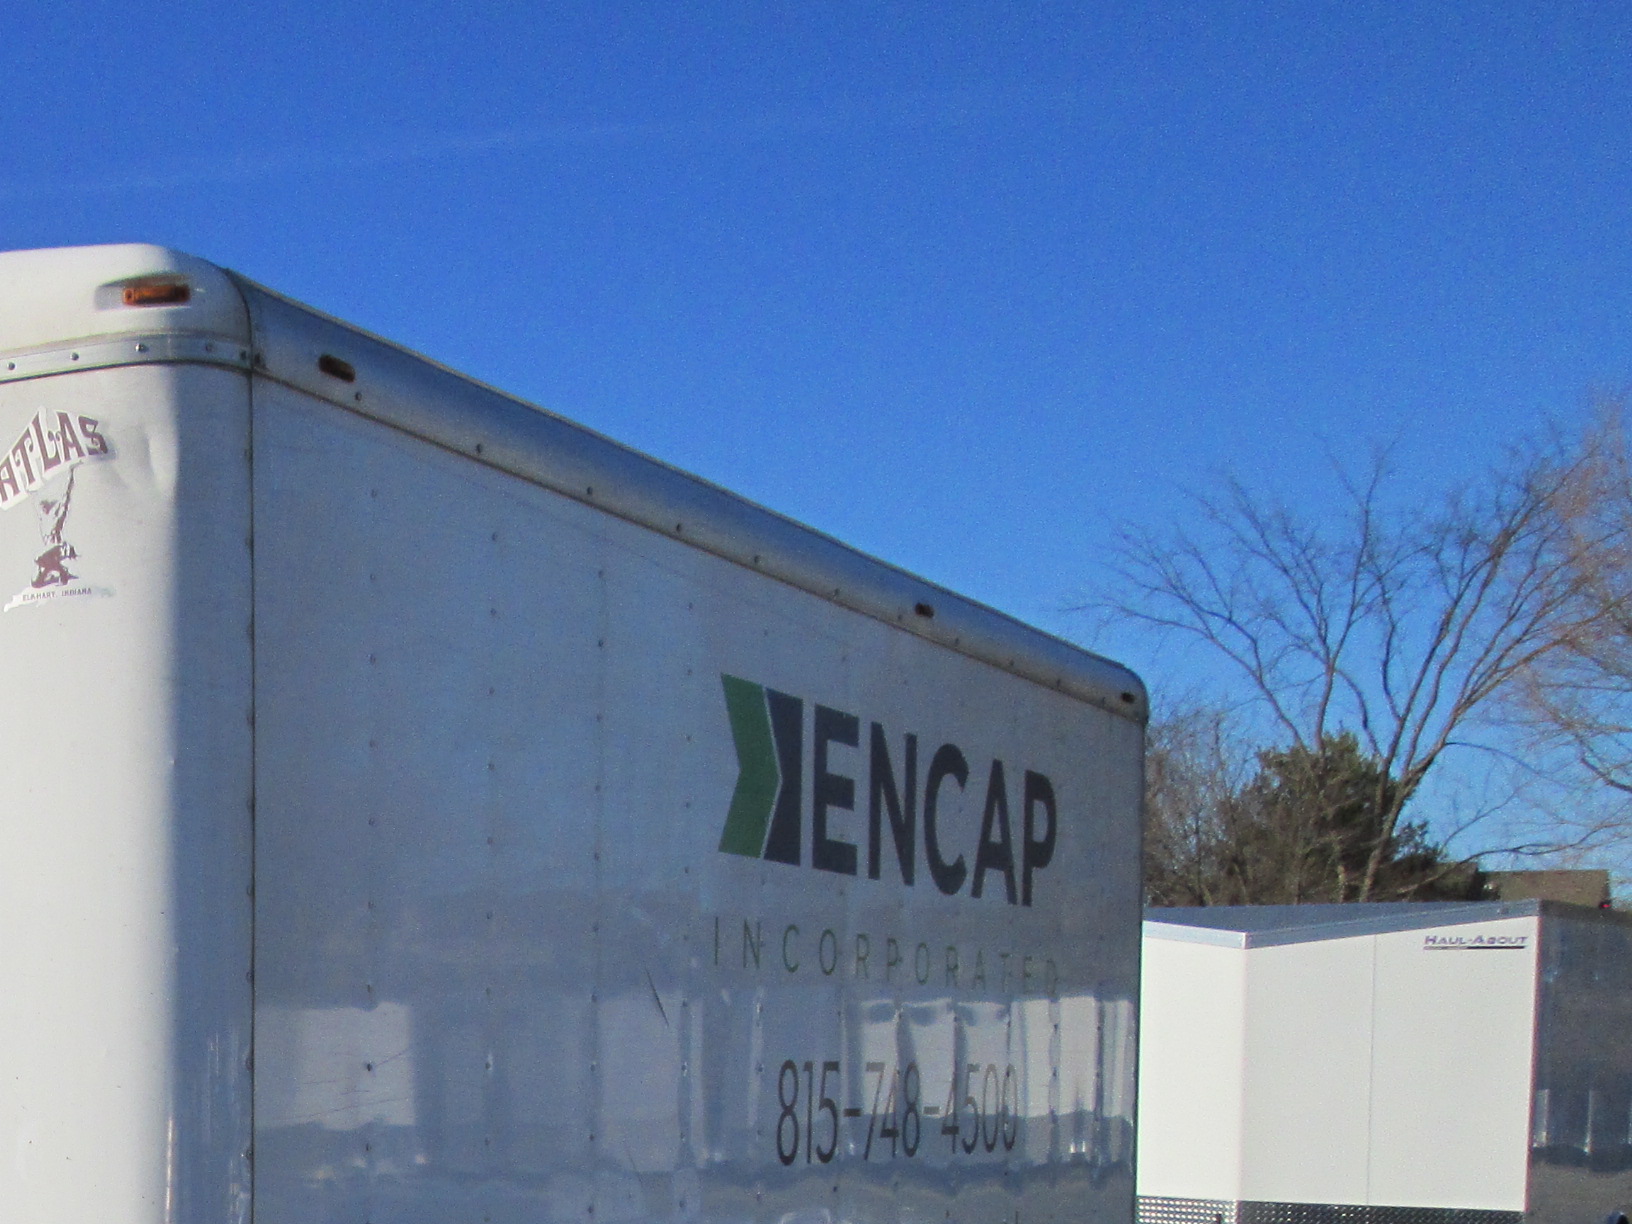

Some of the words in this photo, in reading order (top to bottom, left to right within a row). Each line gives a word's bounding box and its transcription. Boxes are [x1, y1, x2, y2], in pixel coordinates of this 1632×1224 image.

[811, 702, 1058, 908] ENCAP
[713, 916, 1060, 995] INCORPORATED
[775, 1058, 1020, 1167] 815-748-4500
